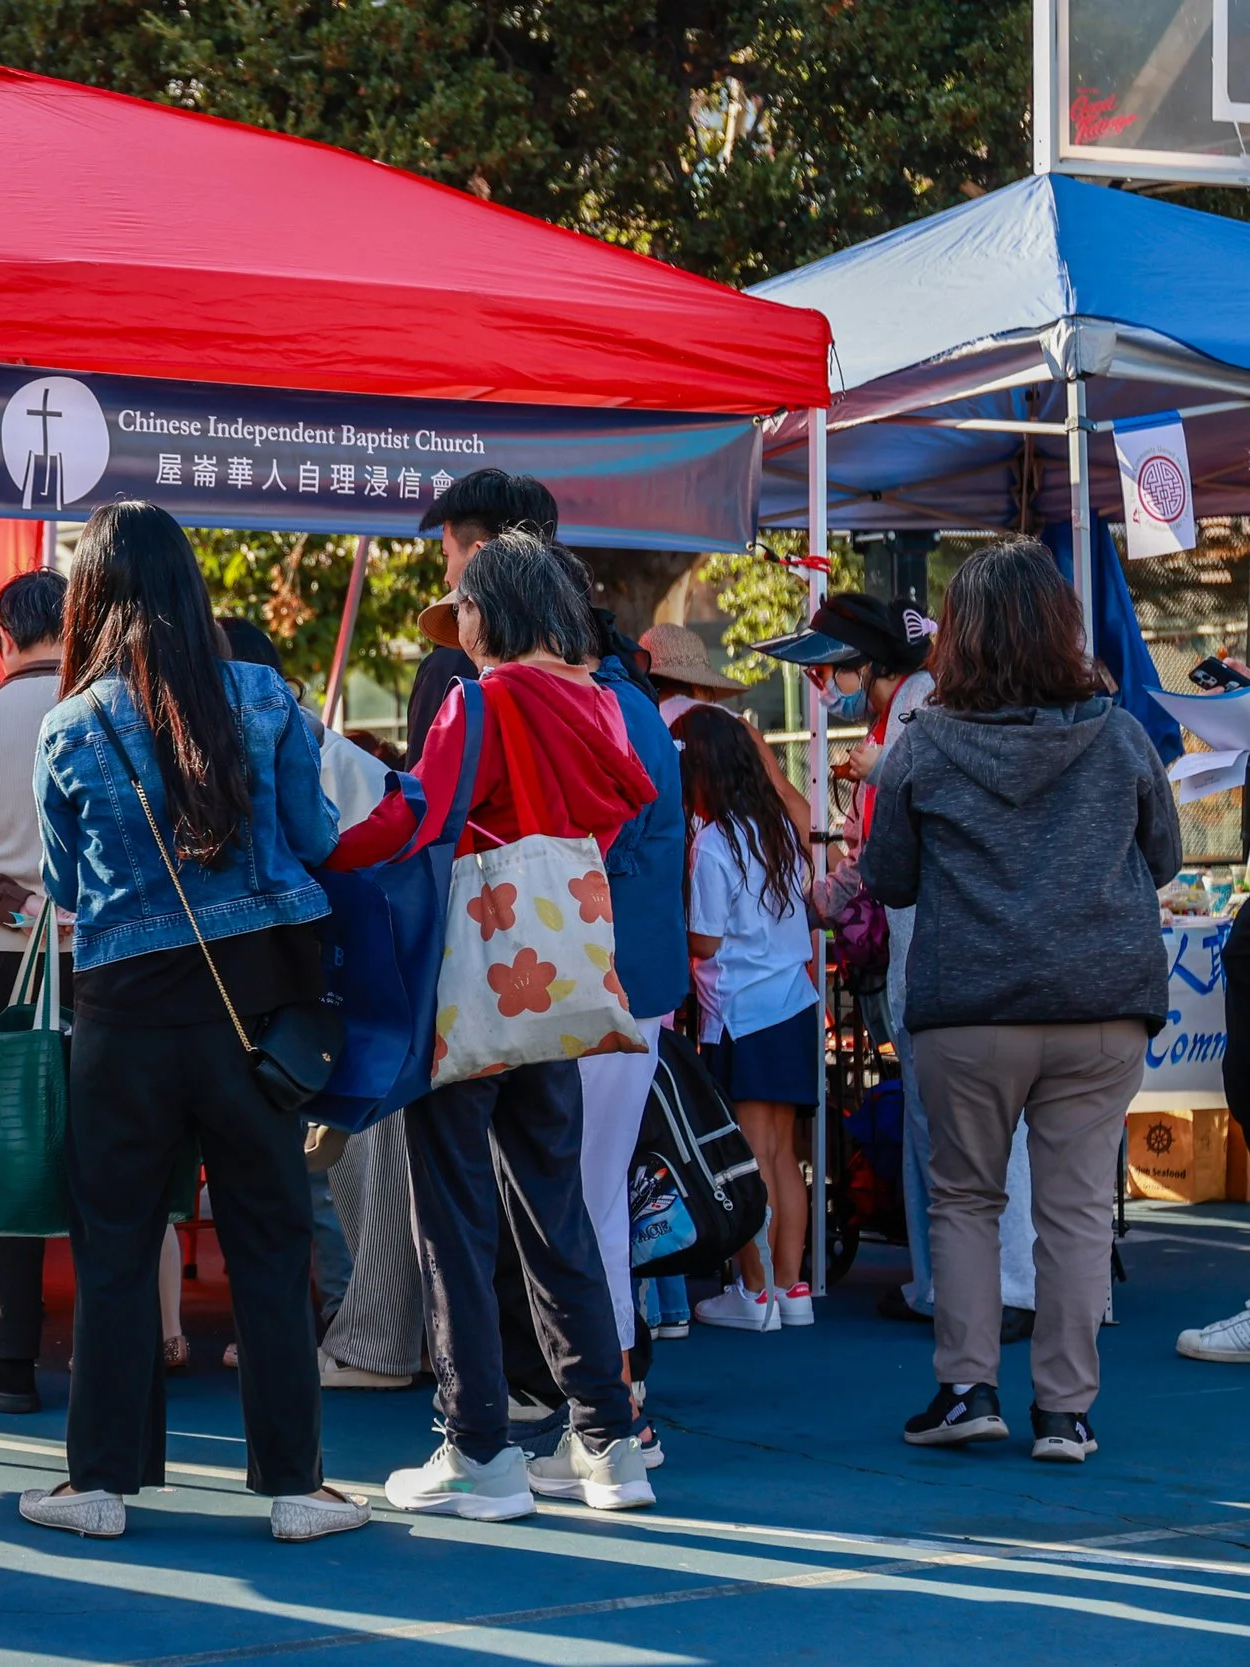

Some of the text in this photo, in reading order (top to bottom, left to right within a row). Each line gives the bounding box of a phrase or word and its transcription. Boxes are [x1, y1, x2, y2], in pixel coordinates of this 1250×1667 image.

[118, 409, 485, 454] Chinese Independent Baptist Church
[156, 453, 454, 500] 屋崙華人自理浸信會
